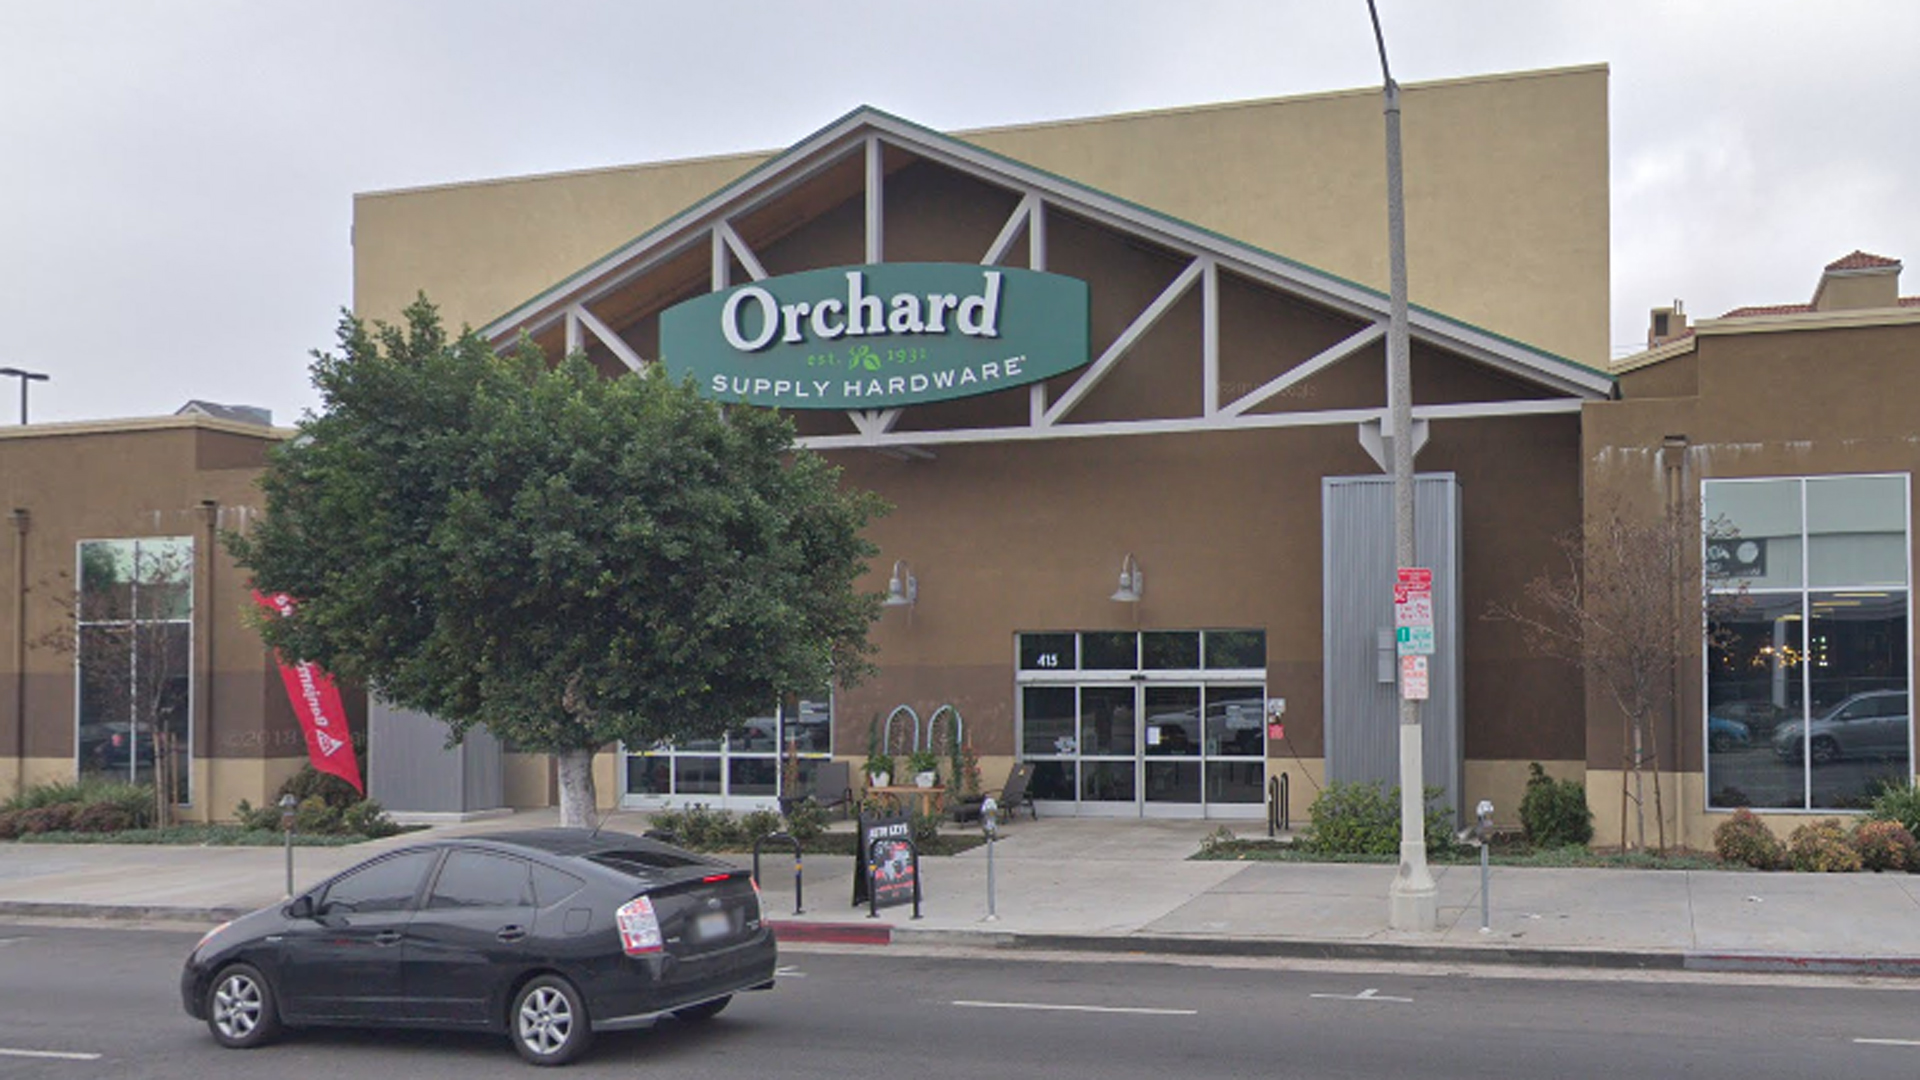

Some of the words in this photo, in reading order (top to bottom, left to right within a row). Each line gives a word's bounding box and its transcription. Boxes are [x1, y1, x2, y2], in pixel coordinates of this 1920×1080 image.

[721, 271, 1002, 351] Orchard
[712, 374, 830, 397] SUPPLY
[1036, 653, 1059, 668] 415
